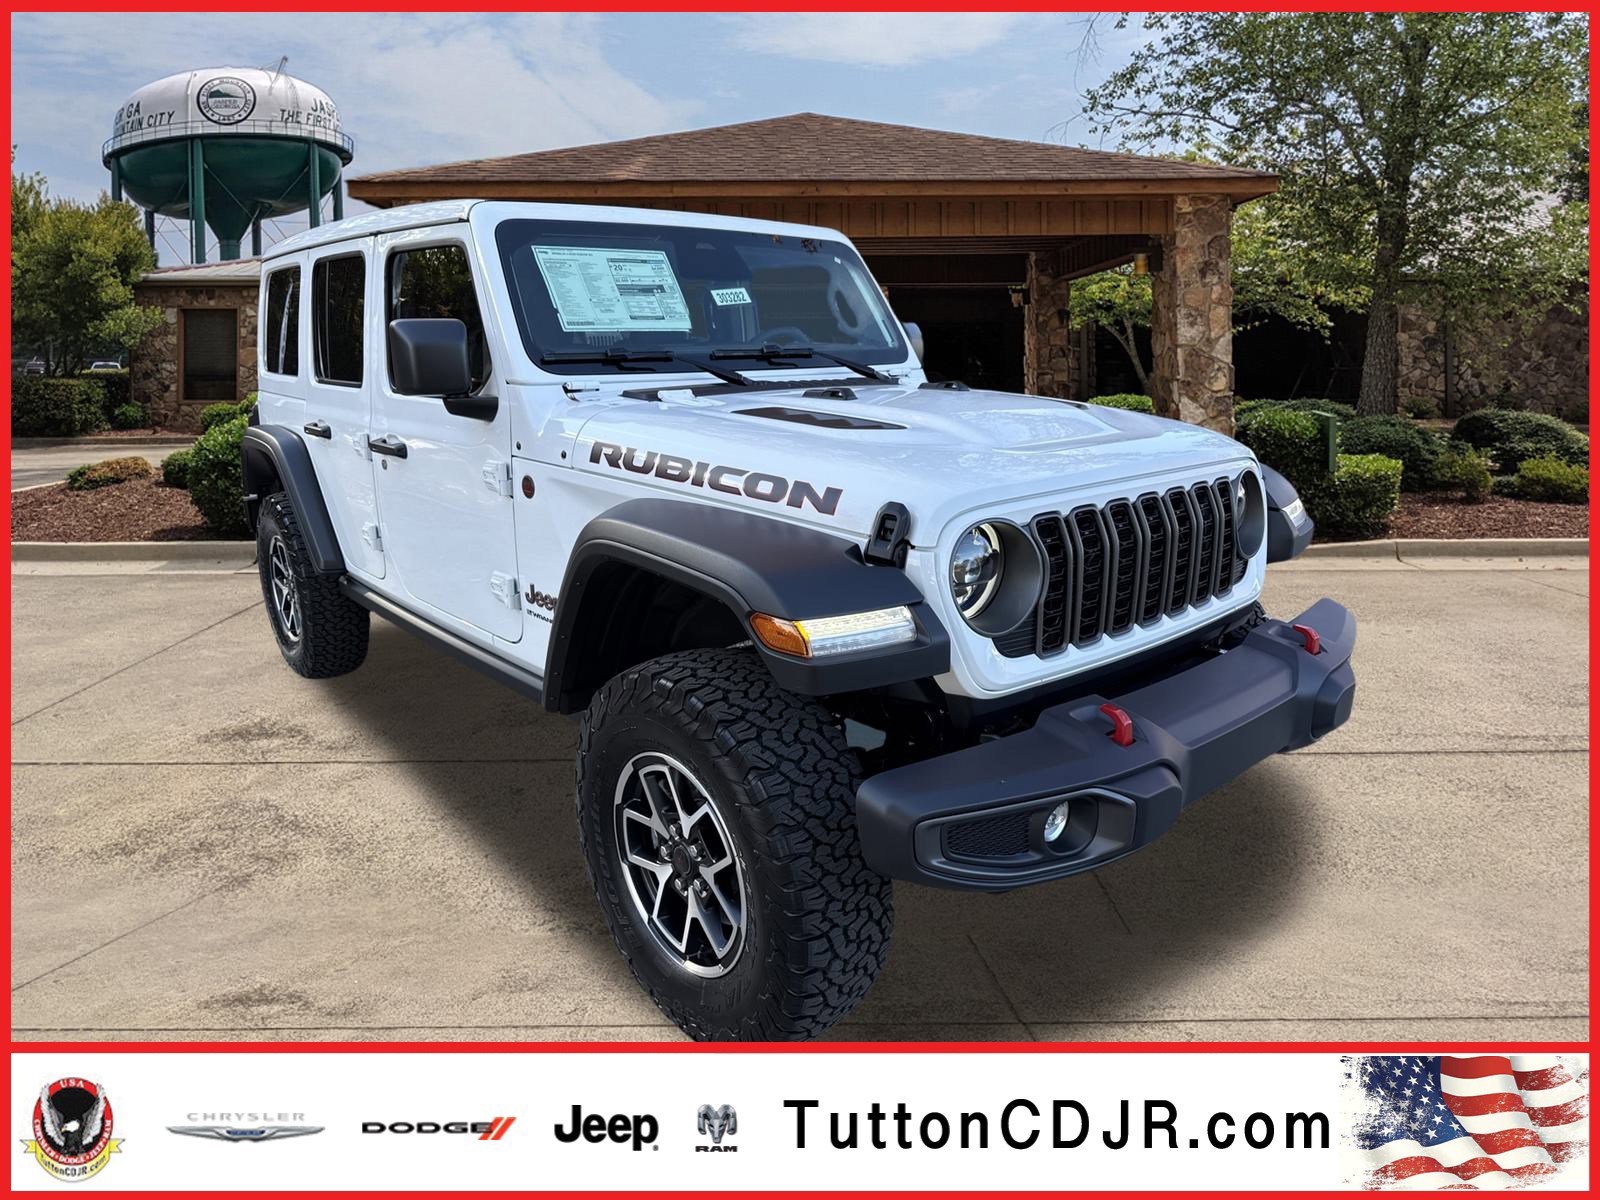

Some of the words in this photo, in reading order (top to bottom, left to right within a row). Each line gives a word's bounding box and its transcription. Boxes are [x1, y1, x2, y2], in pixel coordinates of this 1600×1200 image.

[126, 100, 141, 119] GA
[147, 110, 176, 127] CITY
[279, 108, 302, 124] THE
[305, 112, 332, 130] FIRST
[716, 291, 747, 304] 303282
[588, 440, 844, 516] RUBICON
